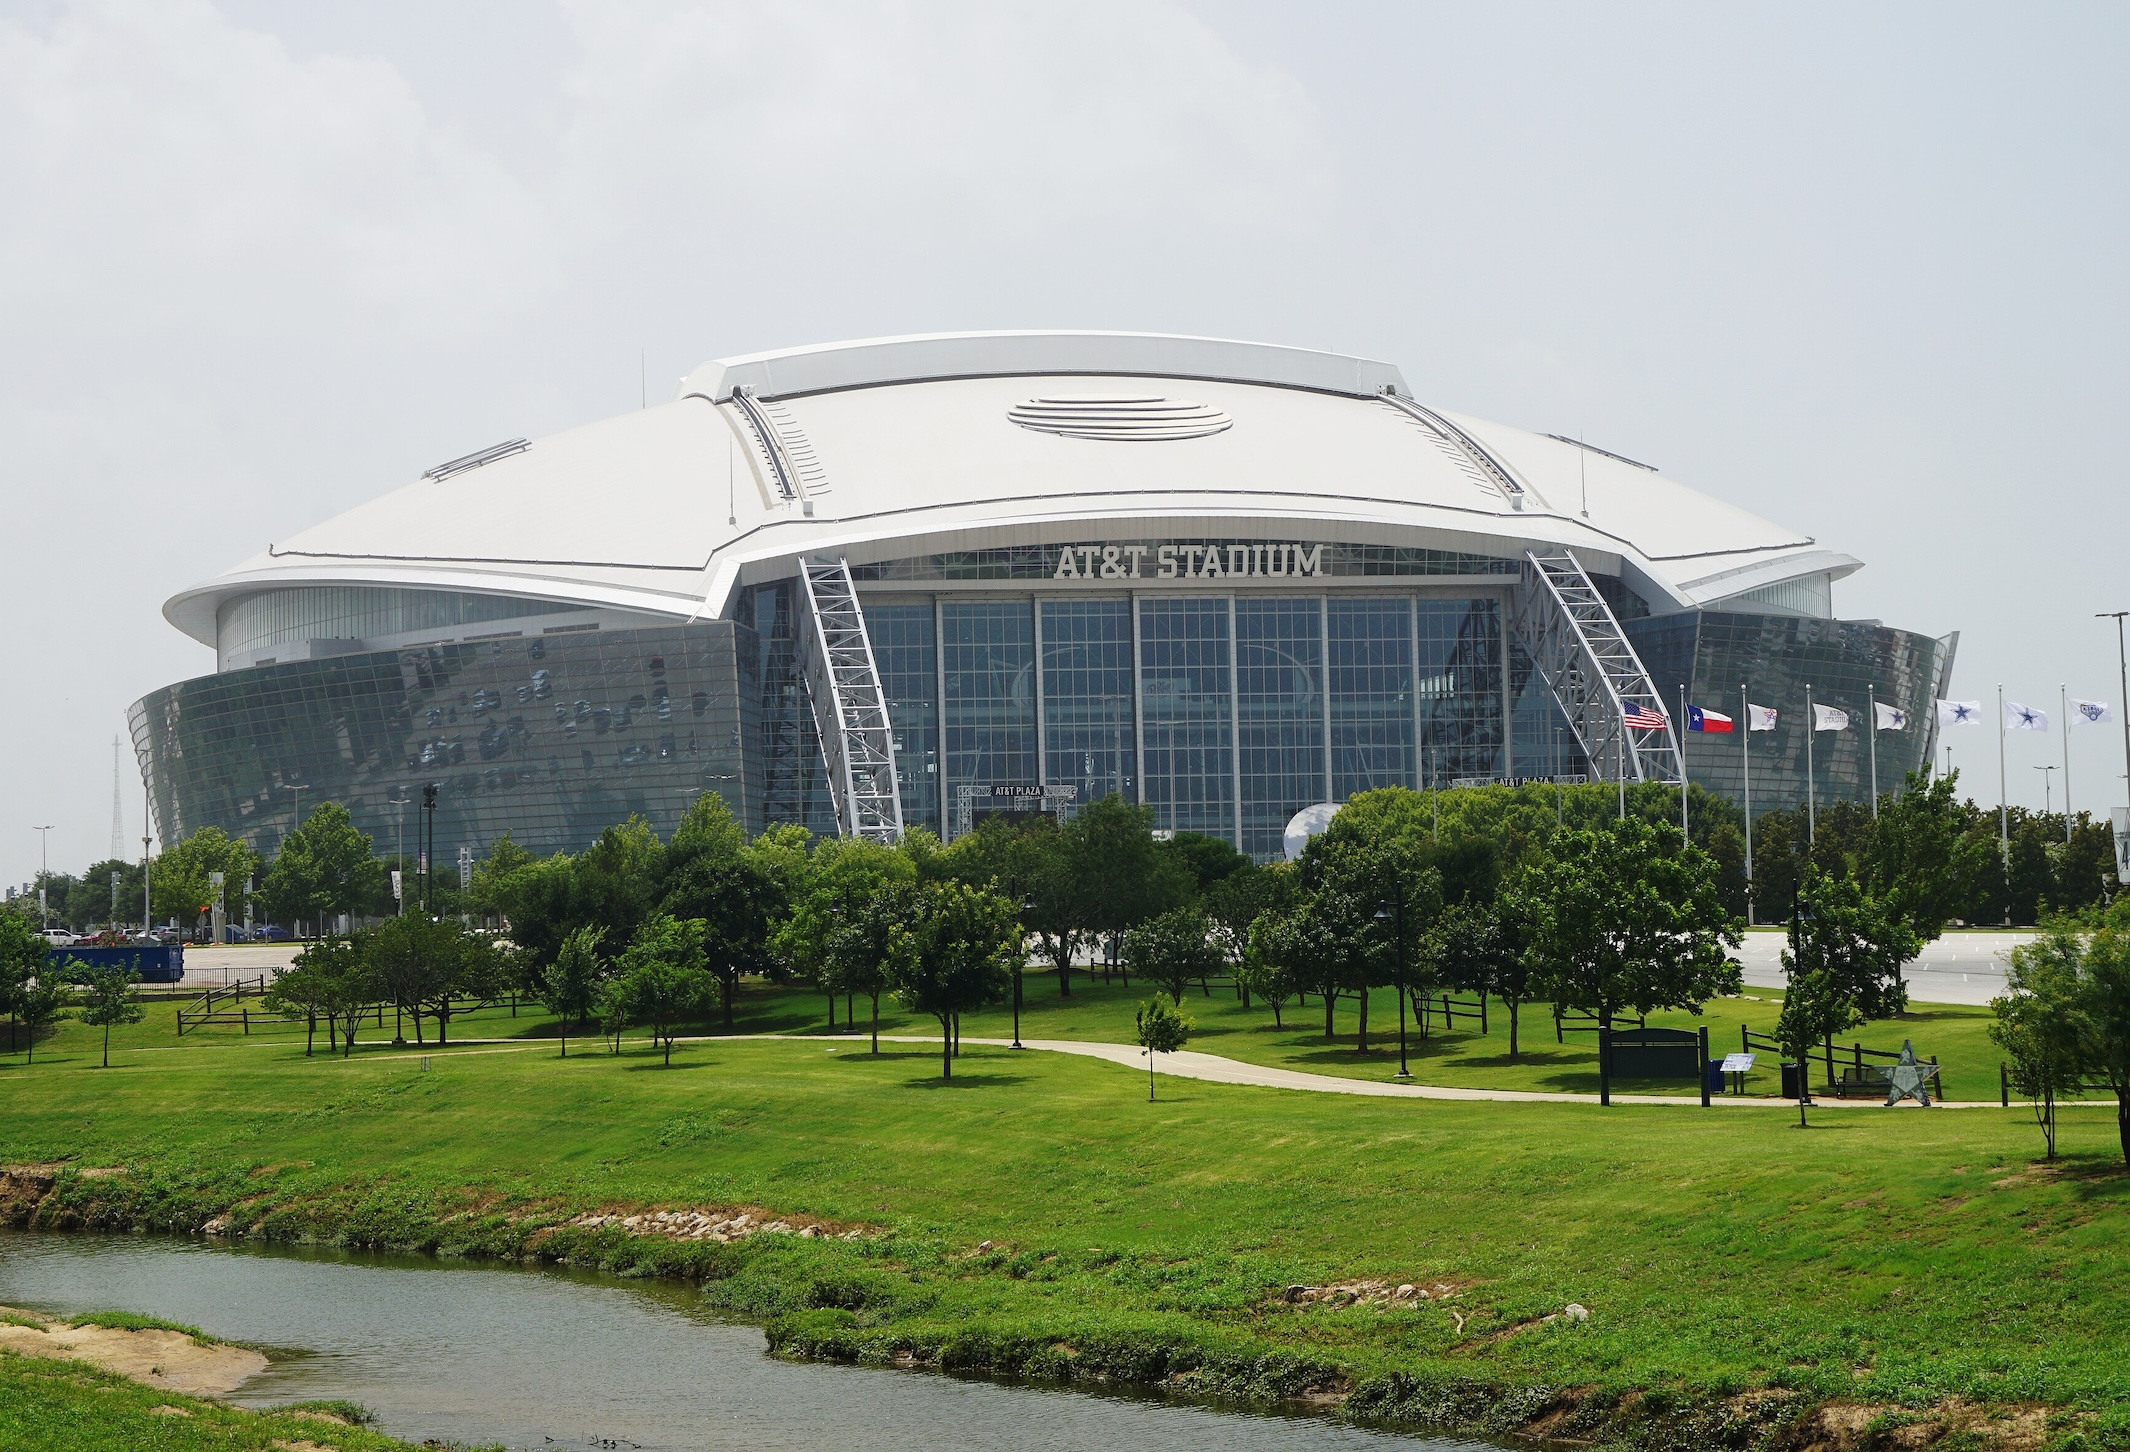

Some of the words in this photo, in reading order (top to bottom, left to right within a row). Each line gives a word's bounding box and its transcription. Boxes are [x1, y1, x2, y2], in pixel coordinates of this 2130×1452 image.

[1053, 545, 1147, 579] AT&T
[1157, 544, 1323, 578] STADIUM
[1499, 777, 1520, 787] AT&T
[995, 786, 1014, 796] AT&T
[1016, 786, 1041, 796] PLAZA
